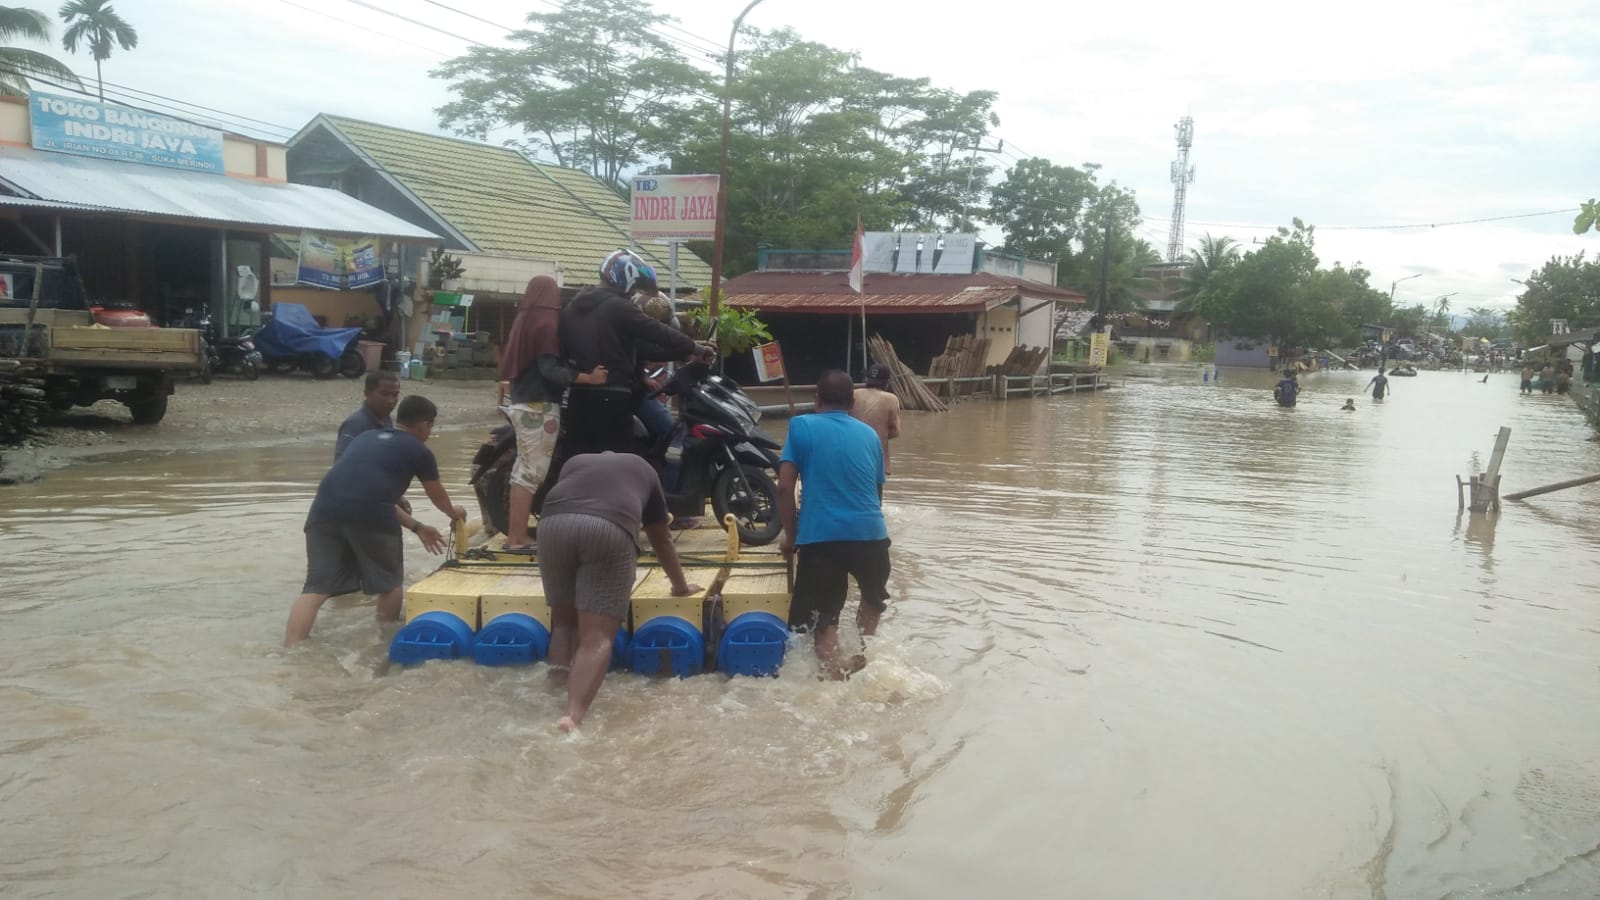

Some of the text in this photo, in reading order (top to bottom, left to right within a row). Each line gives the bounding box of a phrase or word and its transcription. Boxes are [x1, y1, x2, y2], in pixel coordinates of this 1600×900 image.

[38, 97, 99, 120] TOKO
[63, 142, 91, 153] IRIAN
[64, 120, 197, 155] INDRI JAYA
[634, 195, 715, 220] INDRI JAYA
